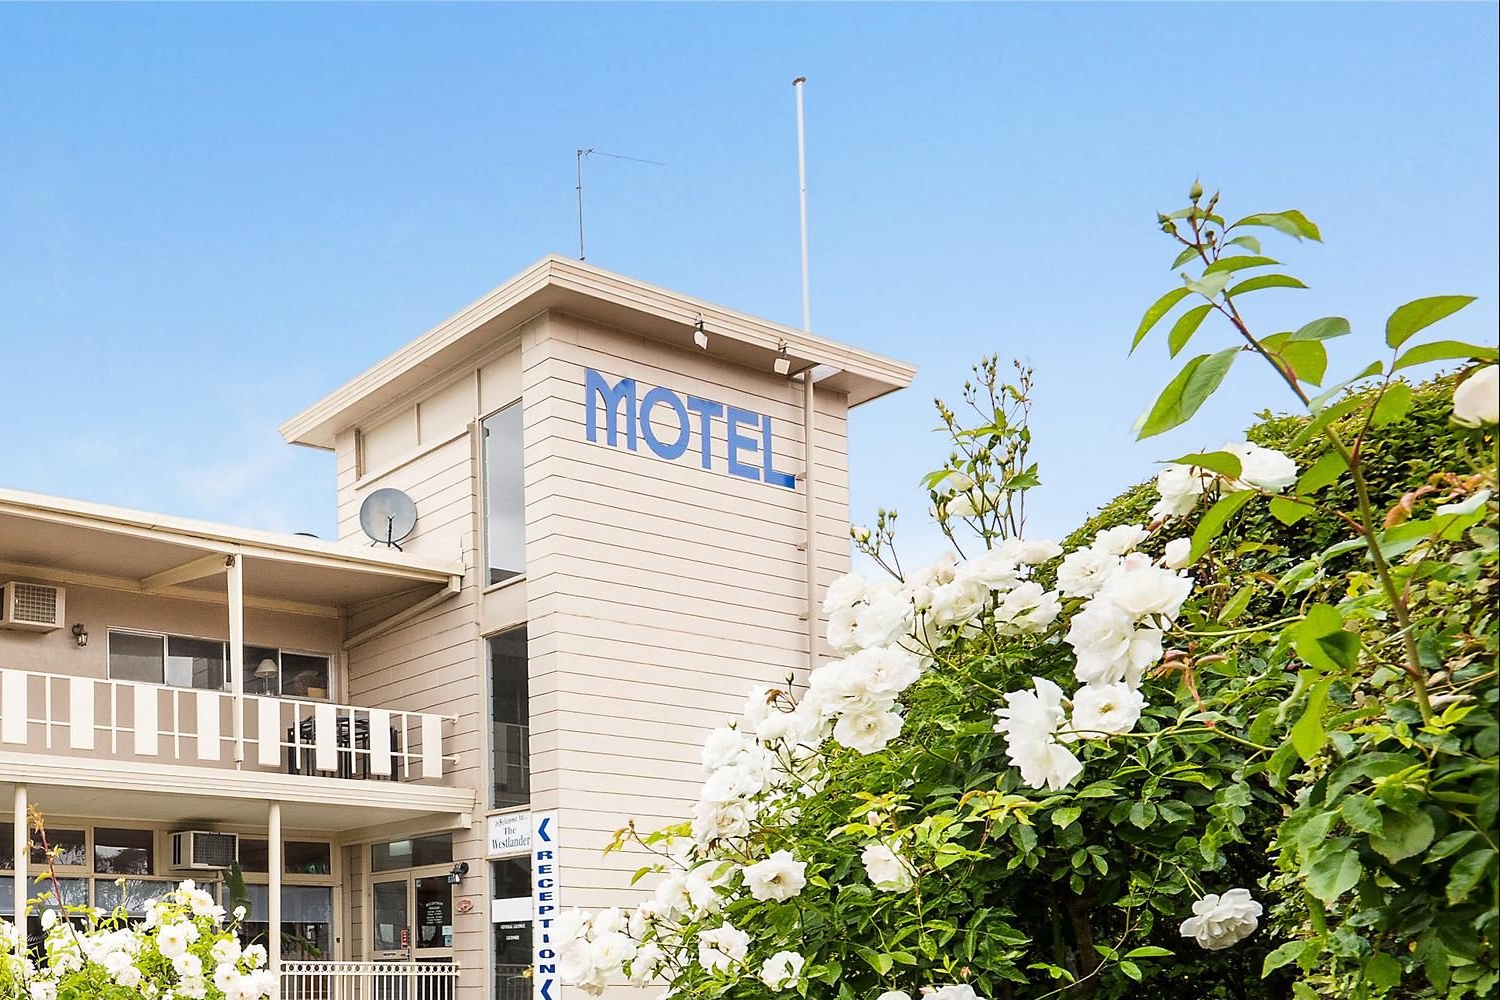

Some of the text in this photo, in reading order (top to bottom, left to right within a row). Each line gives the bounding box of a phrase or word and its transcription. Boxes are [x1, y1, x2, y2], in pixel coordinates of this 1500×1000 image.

[584, 367, 796, 490] MOTEL
[492, 834, 531, 849] Westlander
[504, 826, 517, 835] The
[536, 850, 556, 974] RECEPTION
